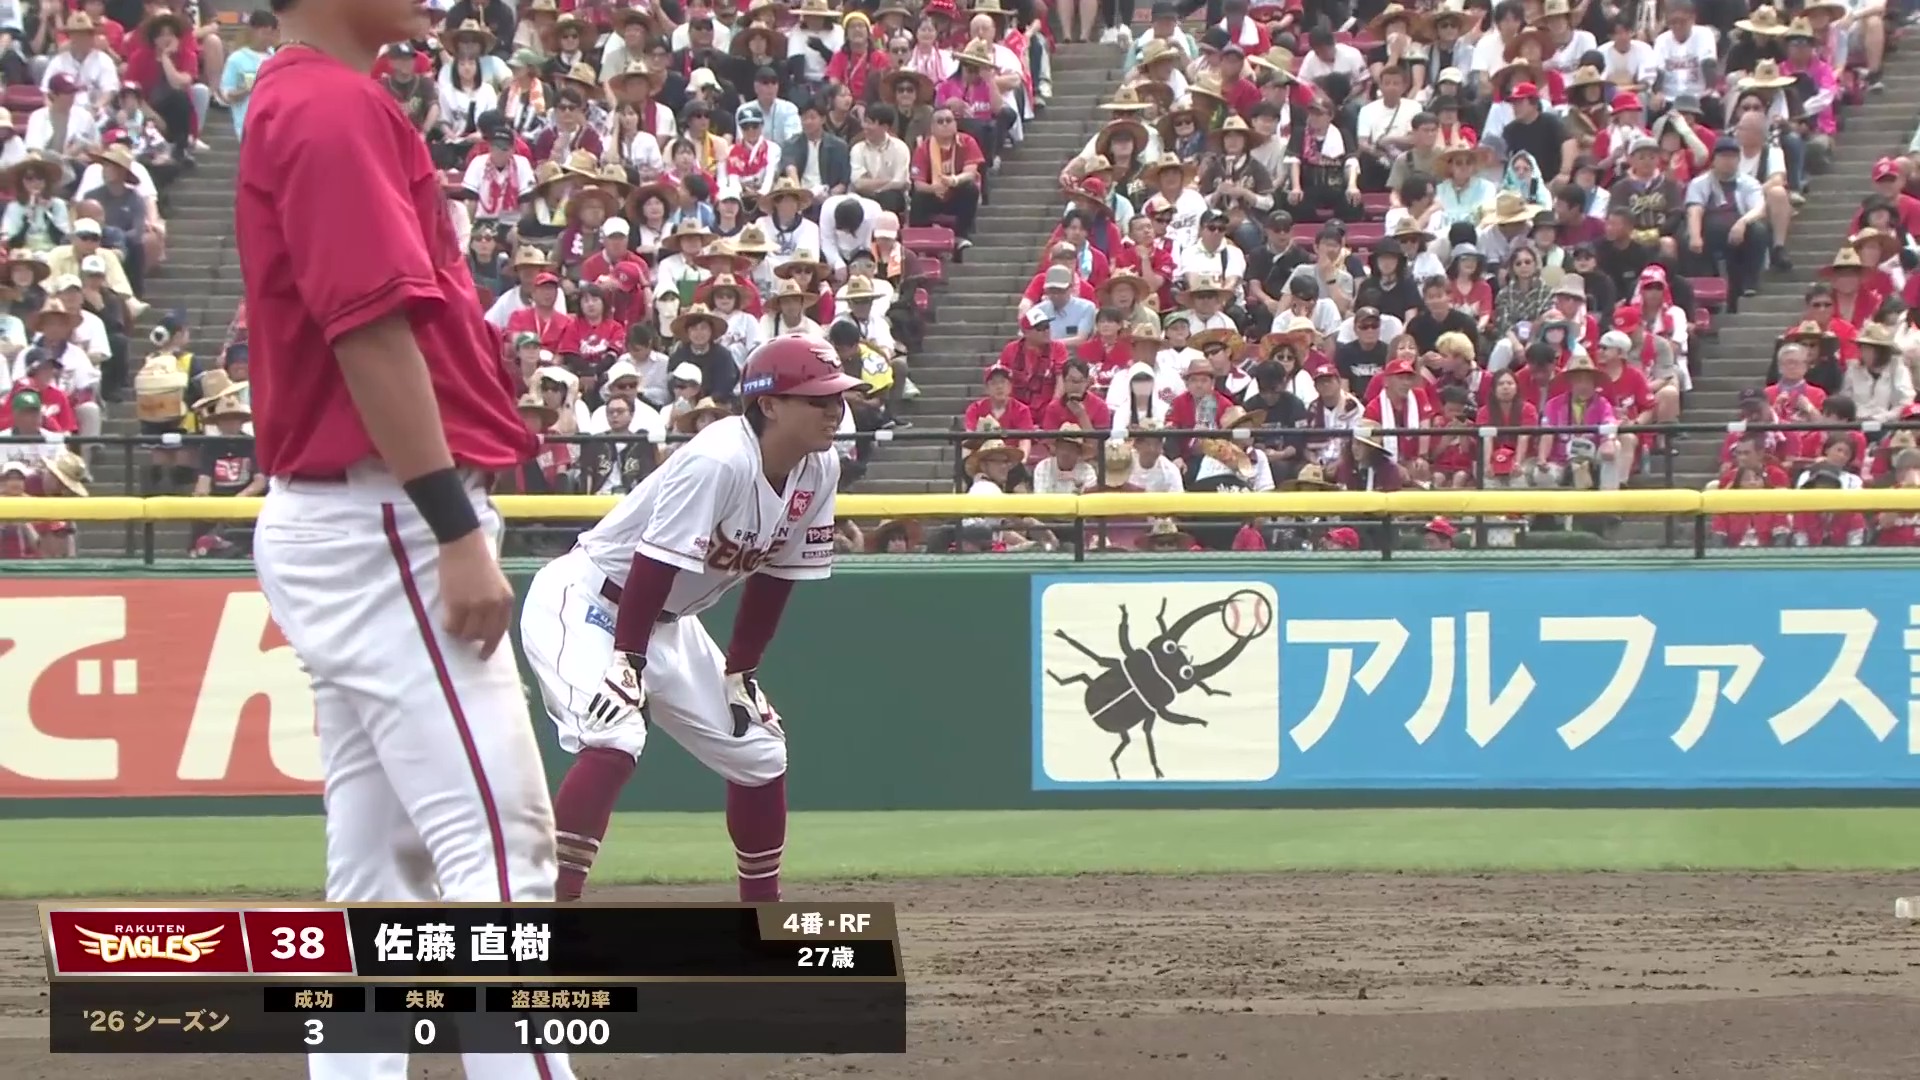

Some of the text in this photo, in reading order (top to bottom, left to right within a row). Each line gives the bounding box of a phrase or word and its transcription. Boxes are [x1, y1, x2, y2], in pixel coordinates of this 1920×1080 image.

[808, 527, 835, 542] やま
[1286, 604, 1920, 755] アルファス
